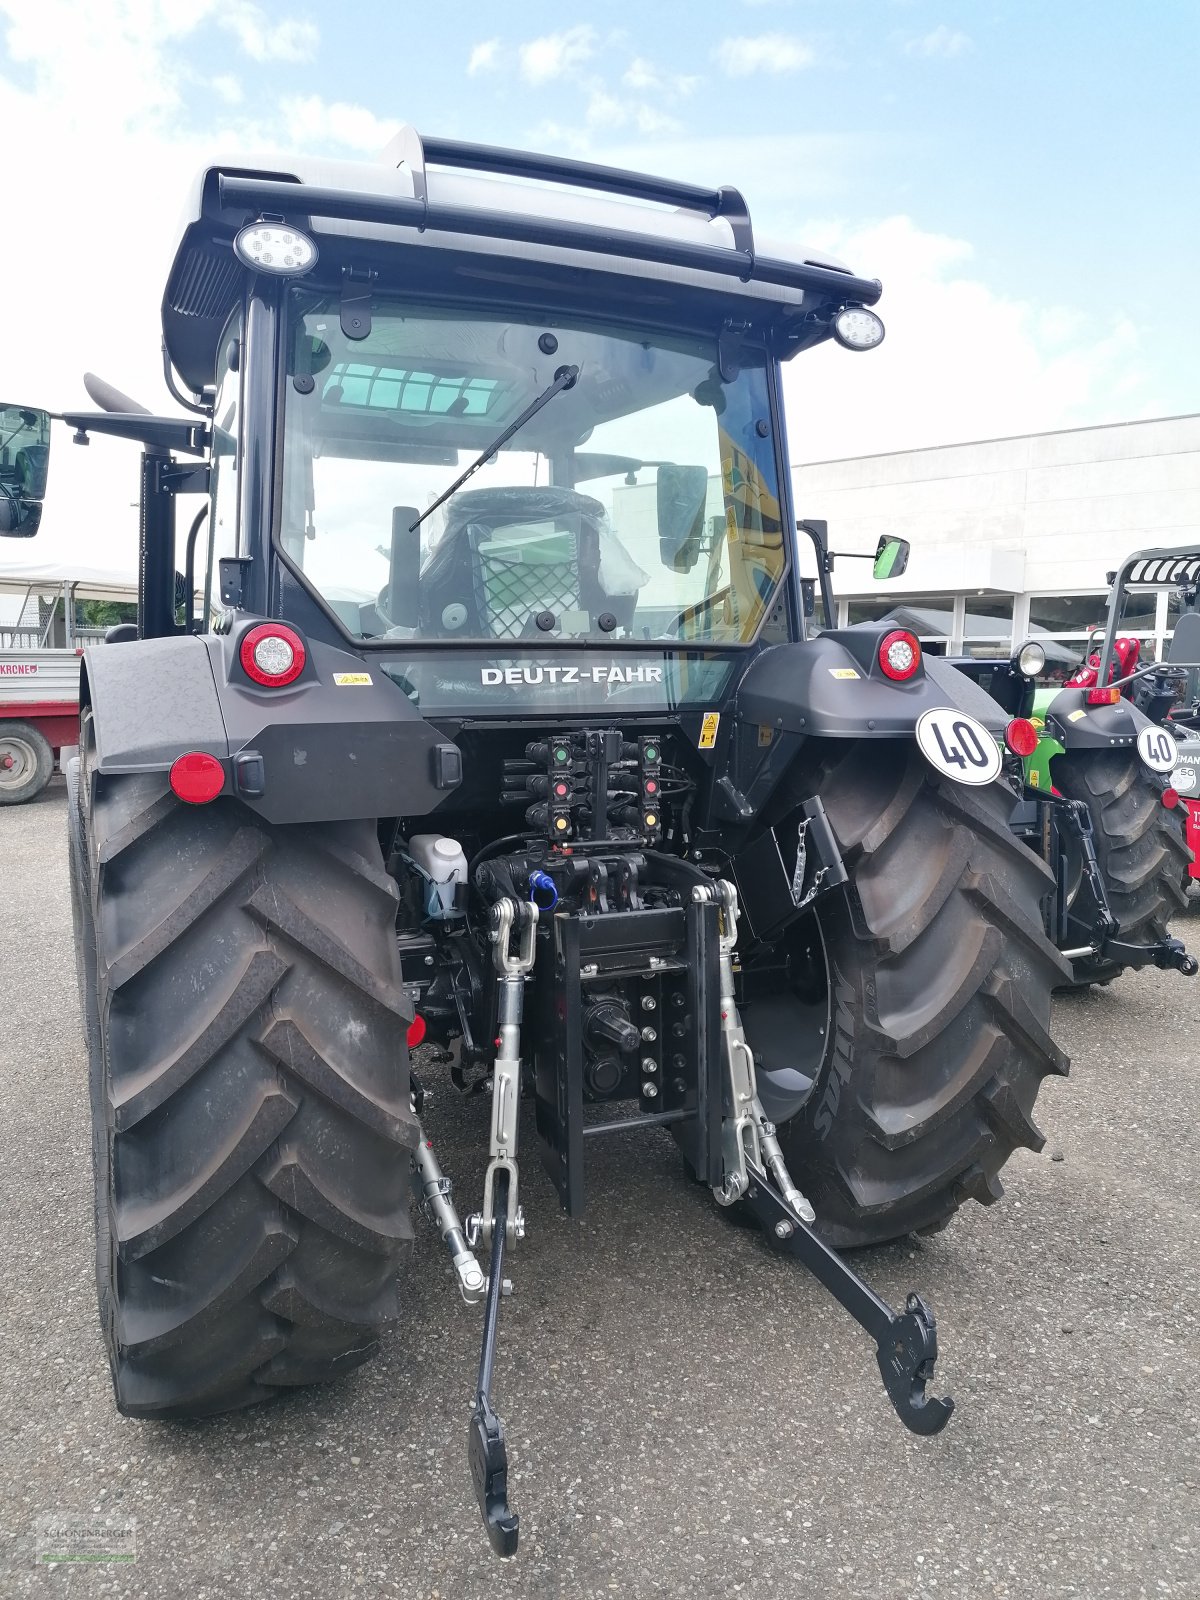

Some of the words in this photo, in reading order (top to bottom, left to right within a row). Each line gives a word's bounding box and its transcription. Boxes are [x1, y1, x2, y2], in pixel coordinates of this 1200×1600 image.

[0, 665, 30, 674] KRONE
[481, 667, 662, 685] DEUTZ-FAHR
[931, 721, 989, 769] 40
[1146, 734, 1172, 763] 40
